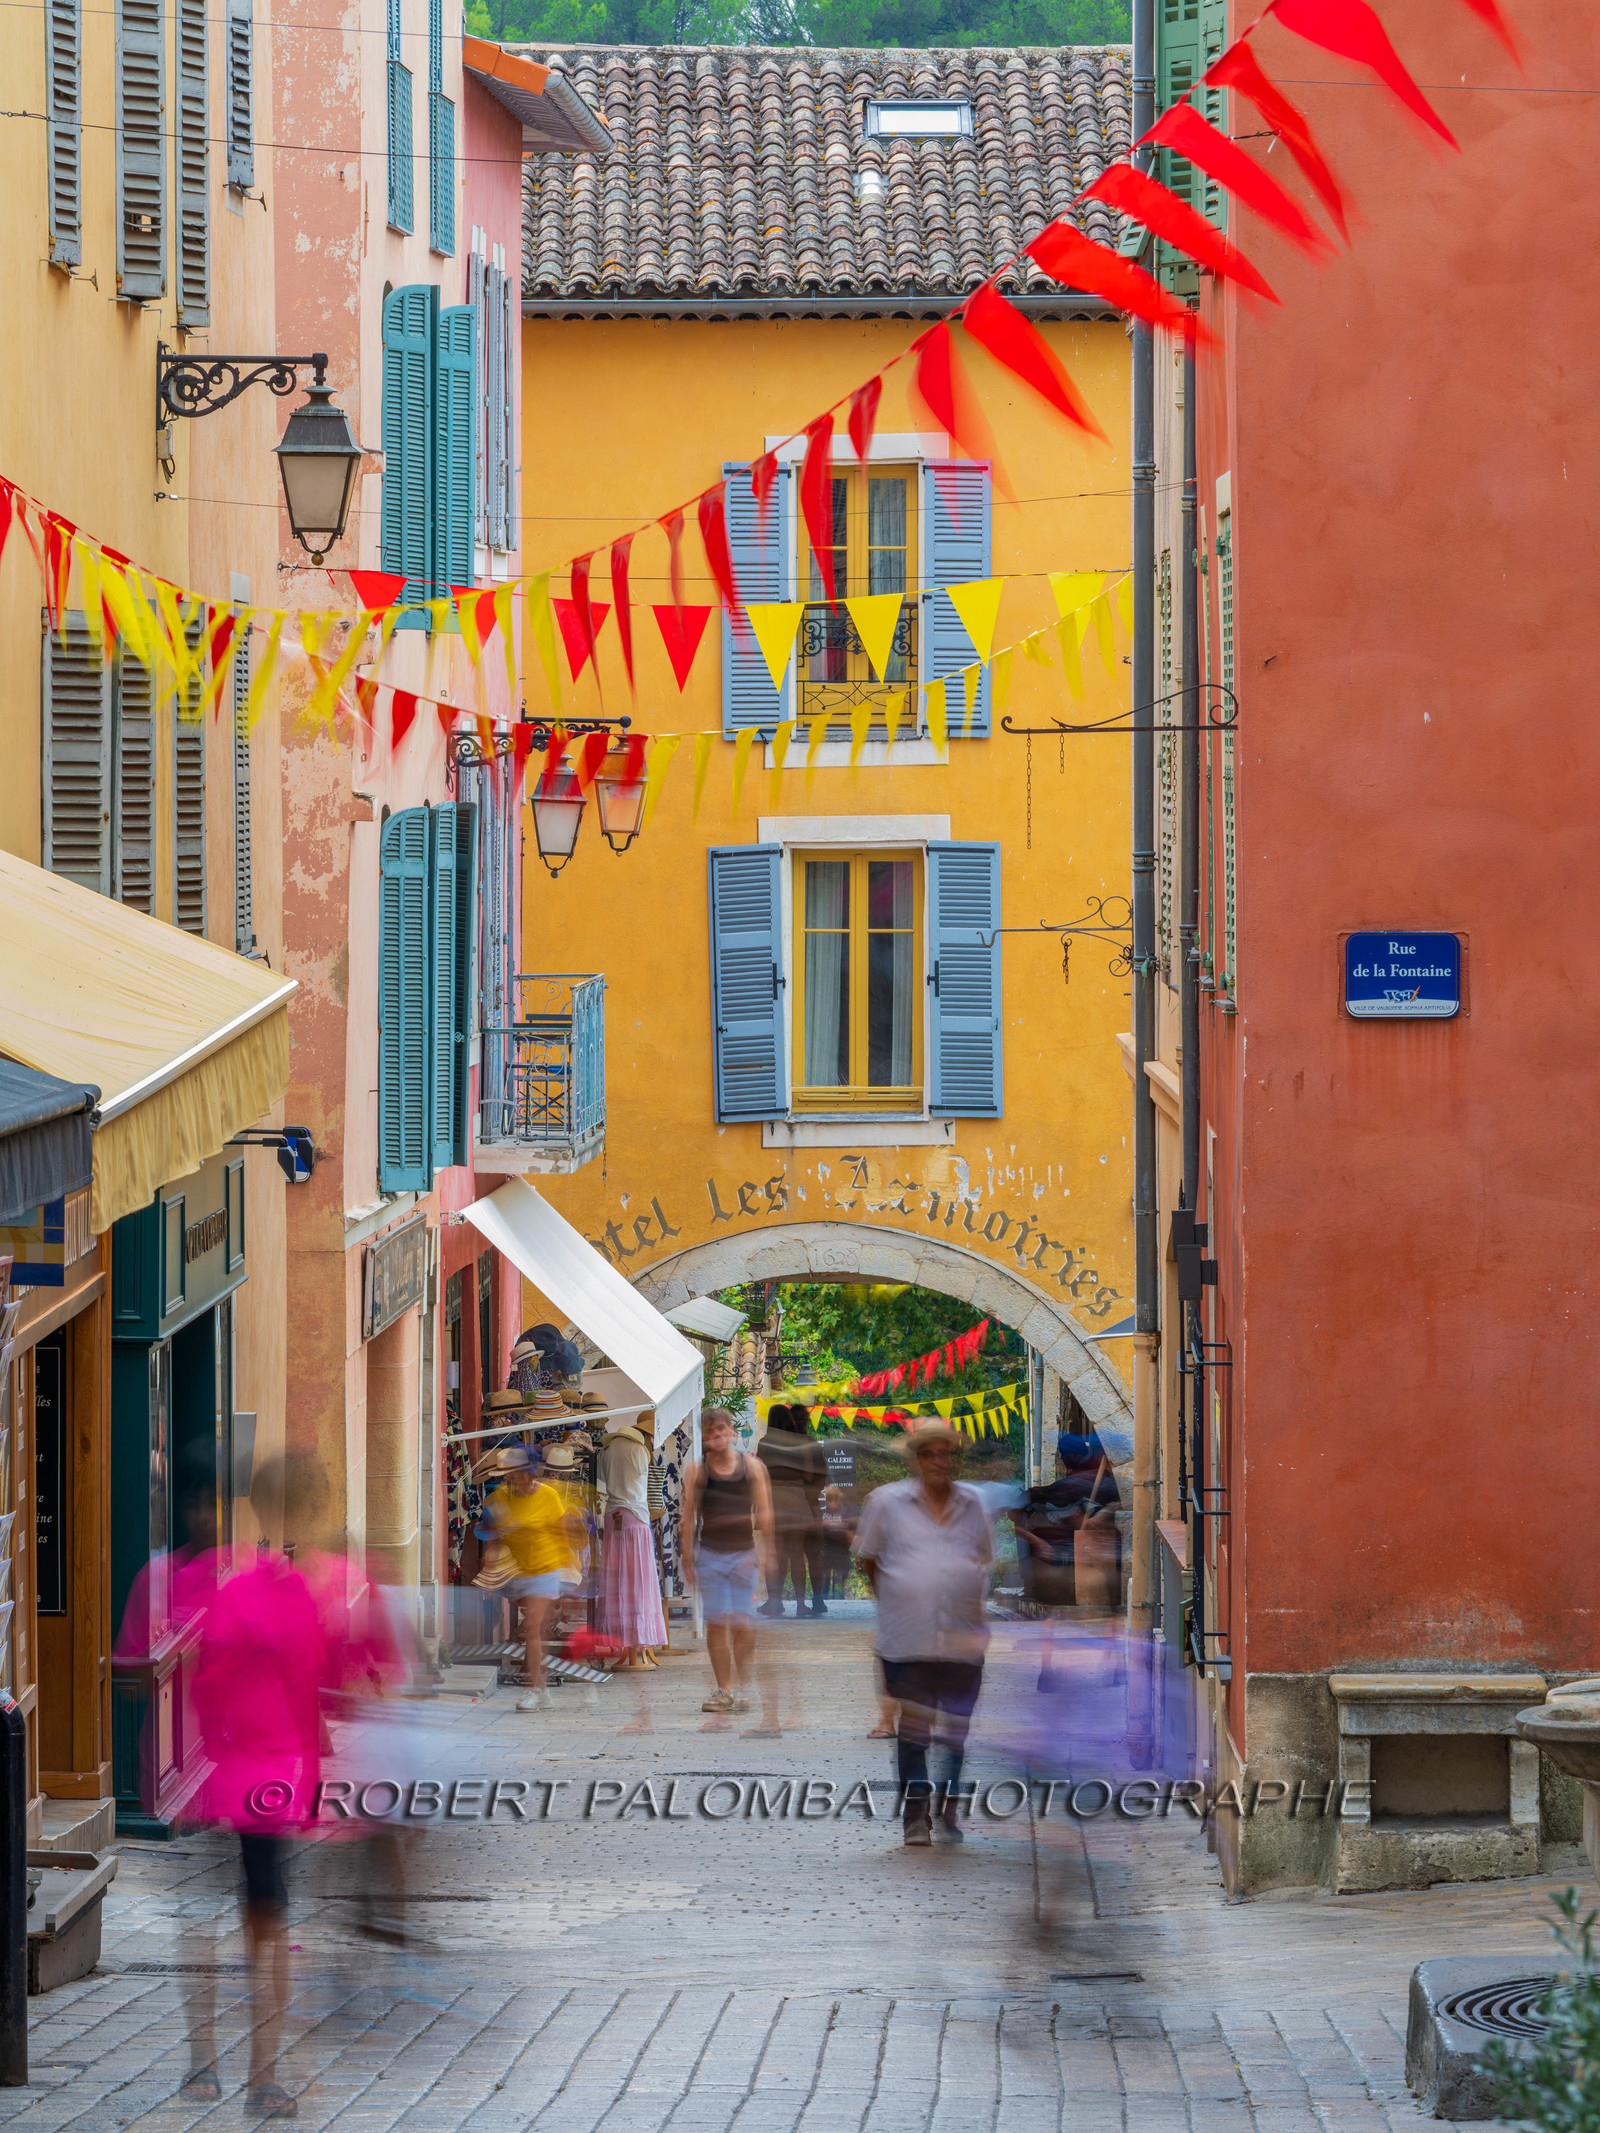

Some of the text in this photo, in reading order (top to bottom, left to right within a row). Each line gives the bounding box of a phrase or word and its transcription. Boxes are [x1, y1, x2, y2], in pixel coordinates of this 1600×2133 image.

[1388, 941, 1417, 955] Rue
[1352, 963, 1452, 977] de la Fontaine
[706, 1173, 788, 1224] les
